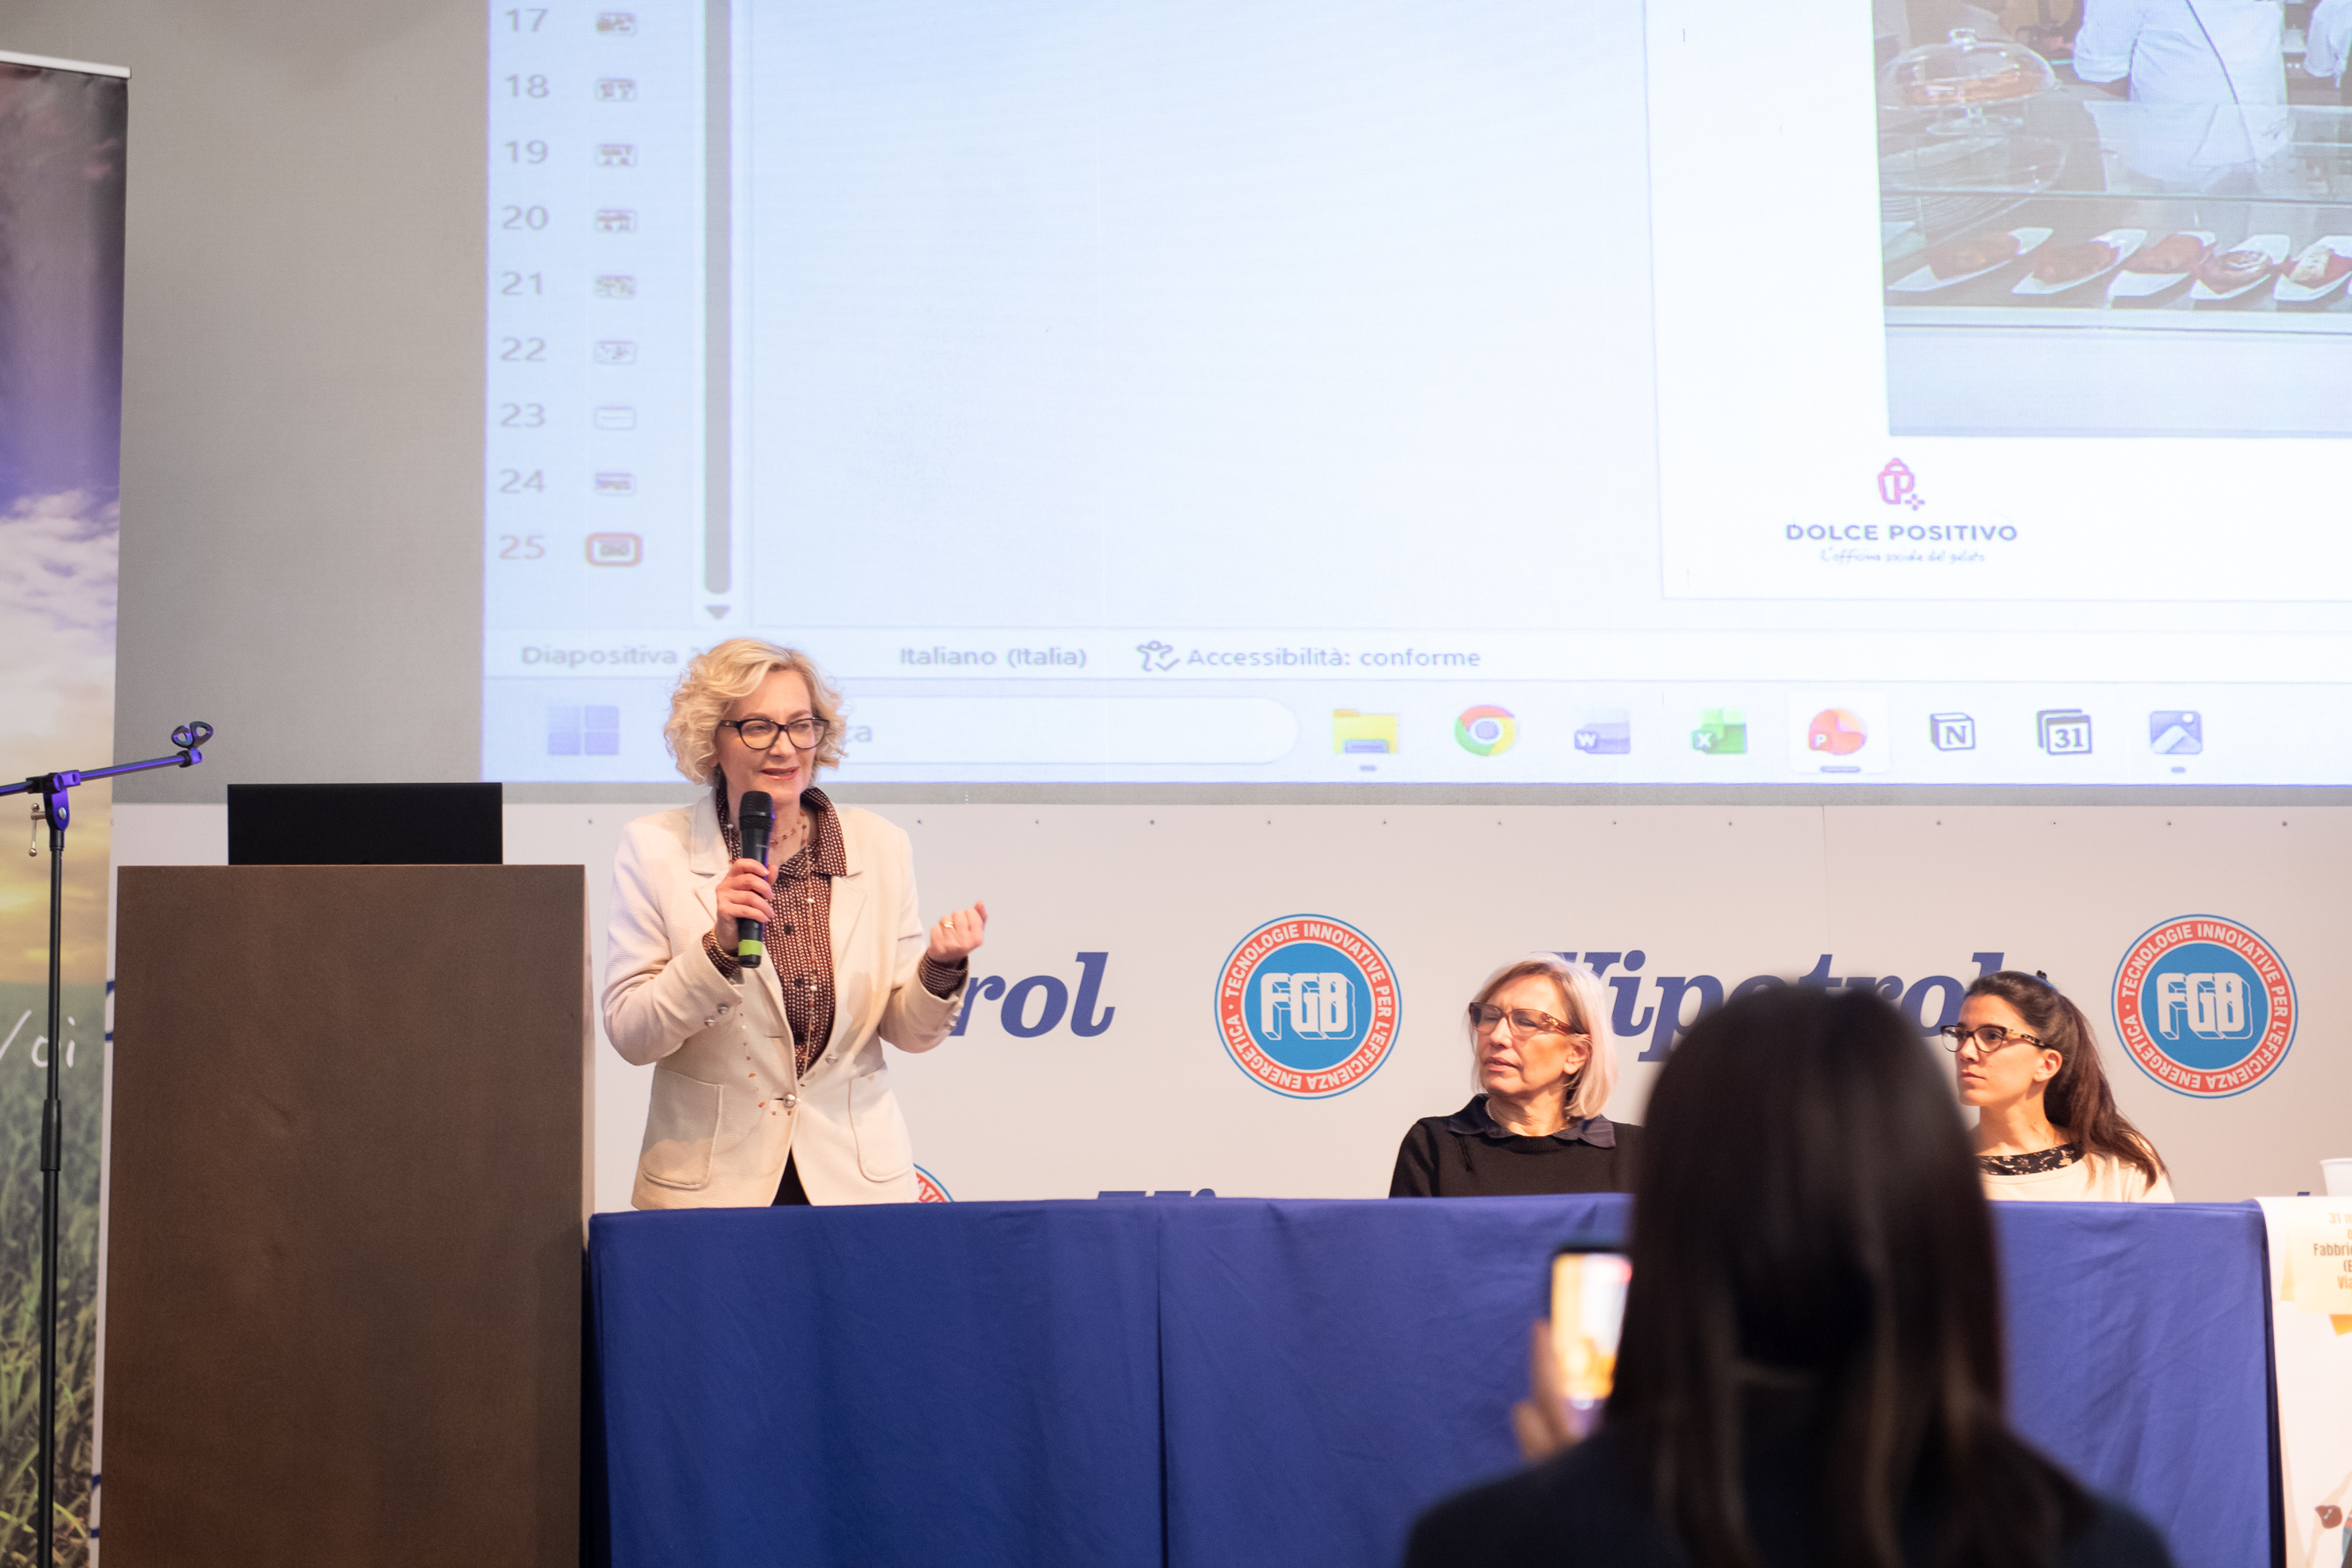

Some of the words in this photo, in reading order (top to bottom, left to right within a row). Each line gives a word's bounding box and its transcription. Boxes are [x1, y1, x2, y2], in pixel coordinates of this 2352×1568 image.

[505, 8, 549, 33] 17
[505, 74, 550, 99] 18
[505, 139, 550, 164] 19
[502, 205, 550, 230] 20
[501, 271, 544, 296] 21
[500, 337, 547, 362] 22
[500, 403, 546, 428] 23
[499, 468, 546, 494] 24
[1786, 524, 1879, 542] DOLCE
[1888, 525, 2018, 542] POSITIVO
[499, 534, 546, 560] 25
[521, 645, 678, 668] Diapositiva
[900, 646, 997, 666] Italiano
[1007, 646, 1086, 668] (Italia)
[1187, 647, 1352, 667] Accessibilità:
[1359, 648, 1481, 667] conforme
[1577, 733, 1597, 747] W
[1696, 733, 1712, 749] X
[1815, 733, 1828, 747] P
[1945, 725, 1968, 745] N
[2054, 727, 2084, 749] 31
[1225, 924, 1299, 997] TECNOLOGIE
[1304, 923, 1386, 983] INNOVATIVE
[2121, 924, 2194, 997] TECNOLOGIE
[2197, 923, 2281, 983] INNOVATIVE
[1261, 972, 1356, 1040] FGB
[1376, 985, 1392, 1017] PER
[2156, 972, 2253, 1040] FGB
[2271, 985, 2288, 1017] PER
[1226, 1014, 1301, 1089] ENERGETICA
[1306, 1021, 1390, 1090] L'EFFICIENZA
[2123, 1014, 2201, 1089] ENERGETICA
[2206, 1021, 2287, 1089] L'EFFICIENZA
